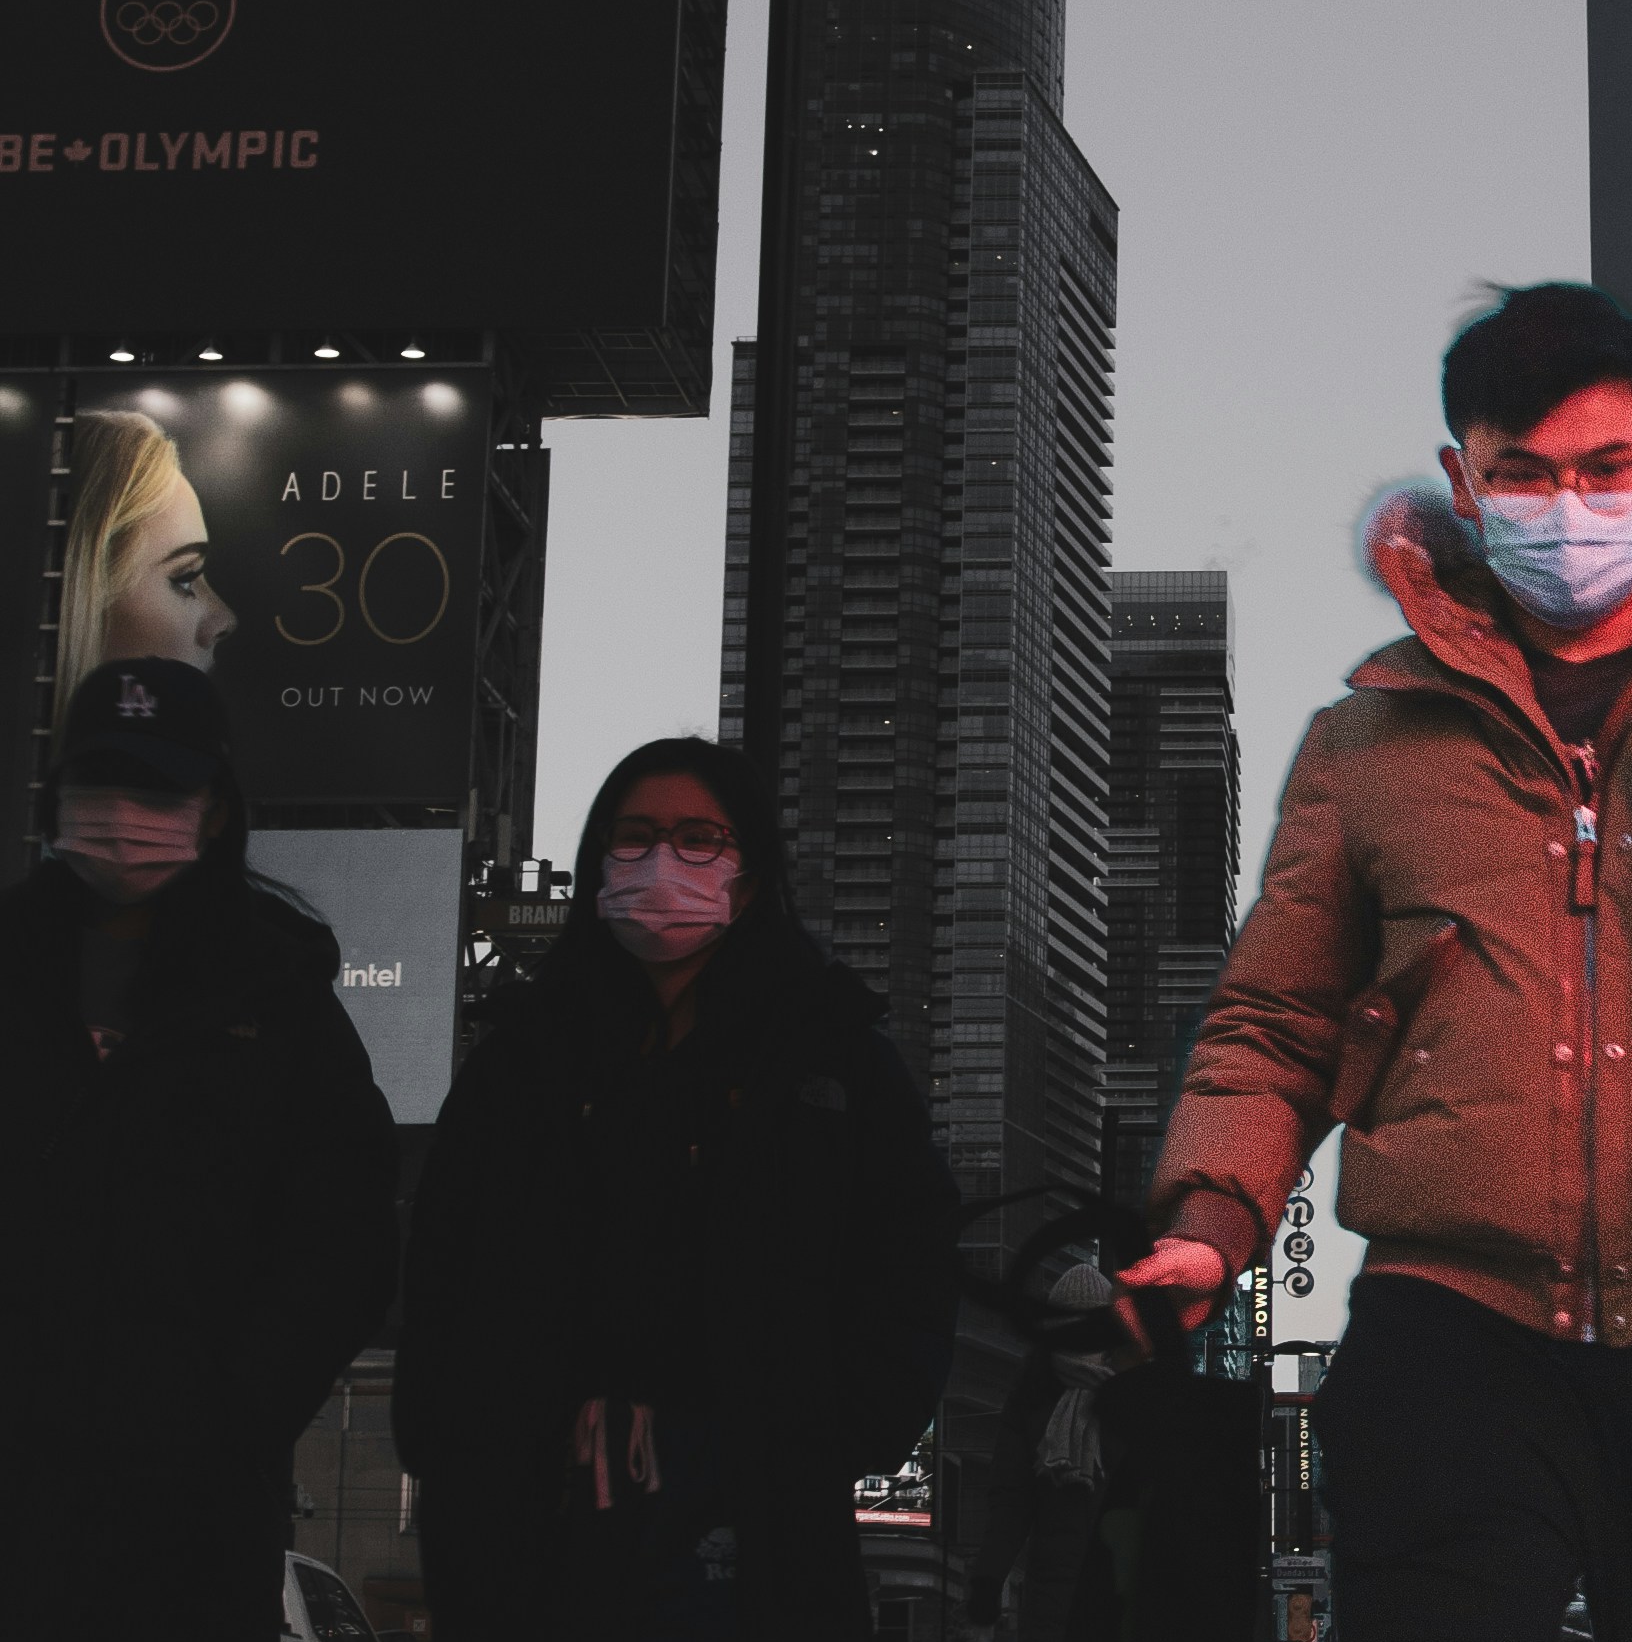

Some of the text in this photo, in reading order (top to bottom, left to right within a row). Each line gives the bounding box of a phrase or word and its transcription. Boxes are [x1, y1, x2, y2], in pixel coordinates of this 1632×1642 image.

[0, 129, 320, 173] BE OLYMPIC
[280, 468, 456, 502] ADELE
[274, 531, 450, 646] 30
[280, 685, 434, 708] OUT NOW
[342, 961, 402, 987] intel
[1300, 1408, 1309, 1490] DOWNTOWN
